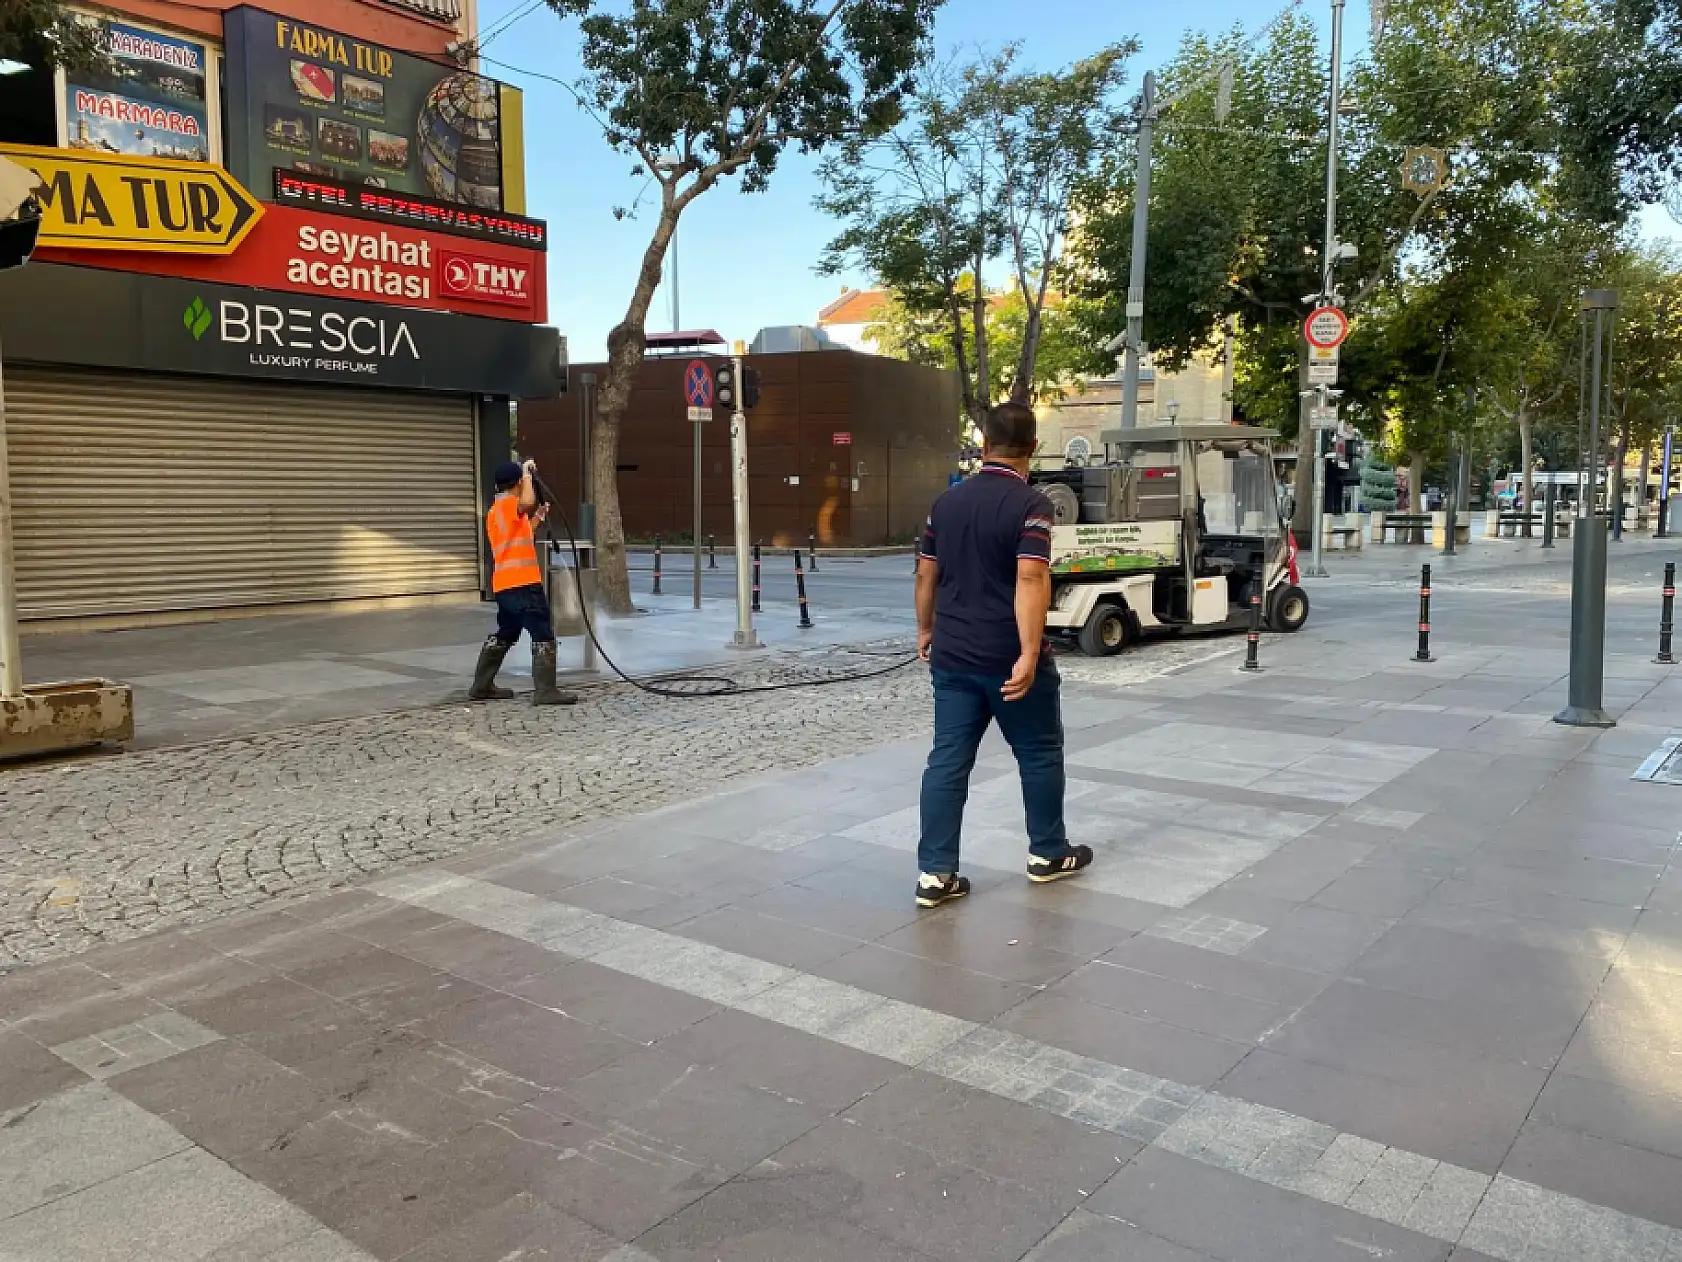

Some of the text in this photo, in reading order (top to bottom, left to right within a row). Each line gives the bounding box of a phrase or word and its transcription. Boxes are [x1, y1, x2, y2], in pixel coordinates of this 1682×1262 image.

[276, 20, 393, 78] FARMA TUR
[75, 90, 199, 136] MARMARA
[120, 176, 223, 234] TUR
[298, 225, 431, 268] seyahat
[287, 258, 430, 299] acentası
[473, 262, 527, 290] THY
[220, 300, 421, 360] BRESCIA
[249, 351, 379, 375] LUXURY PERFUME
